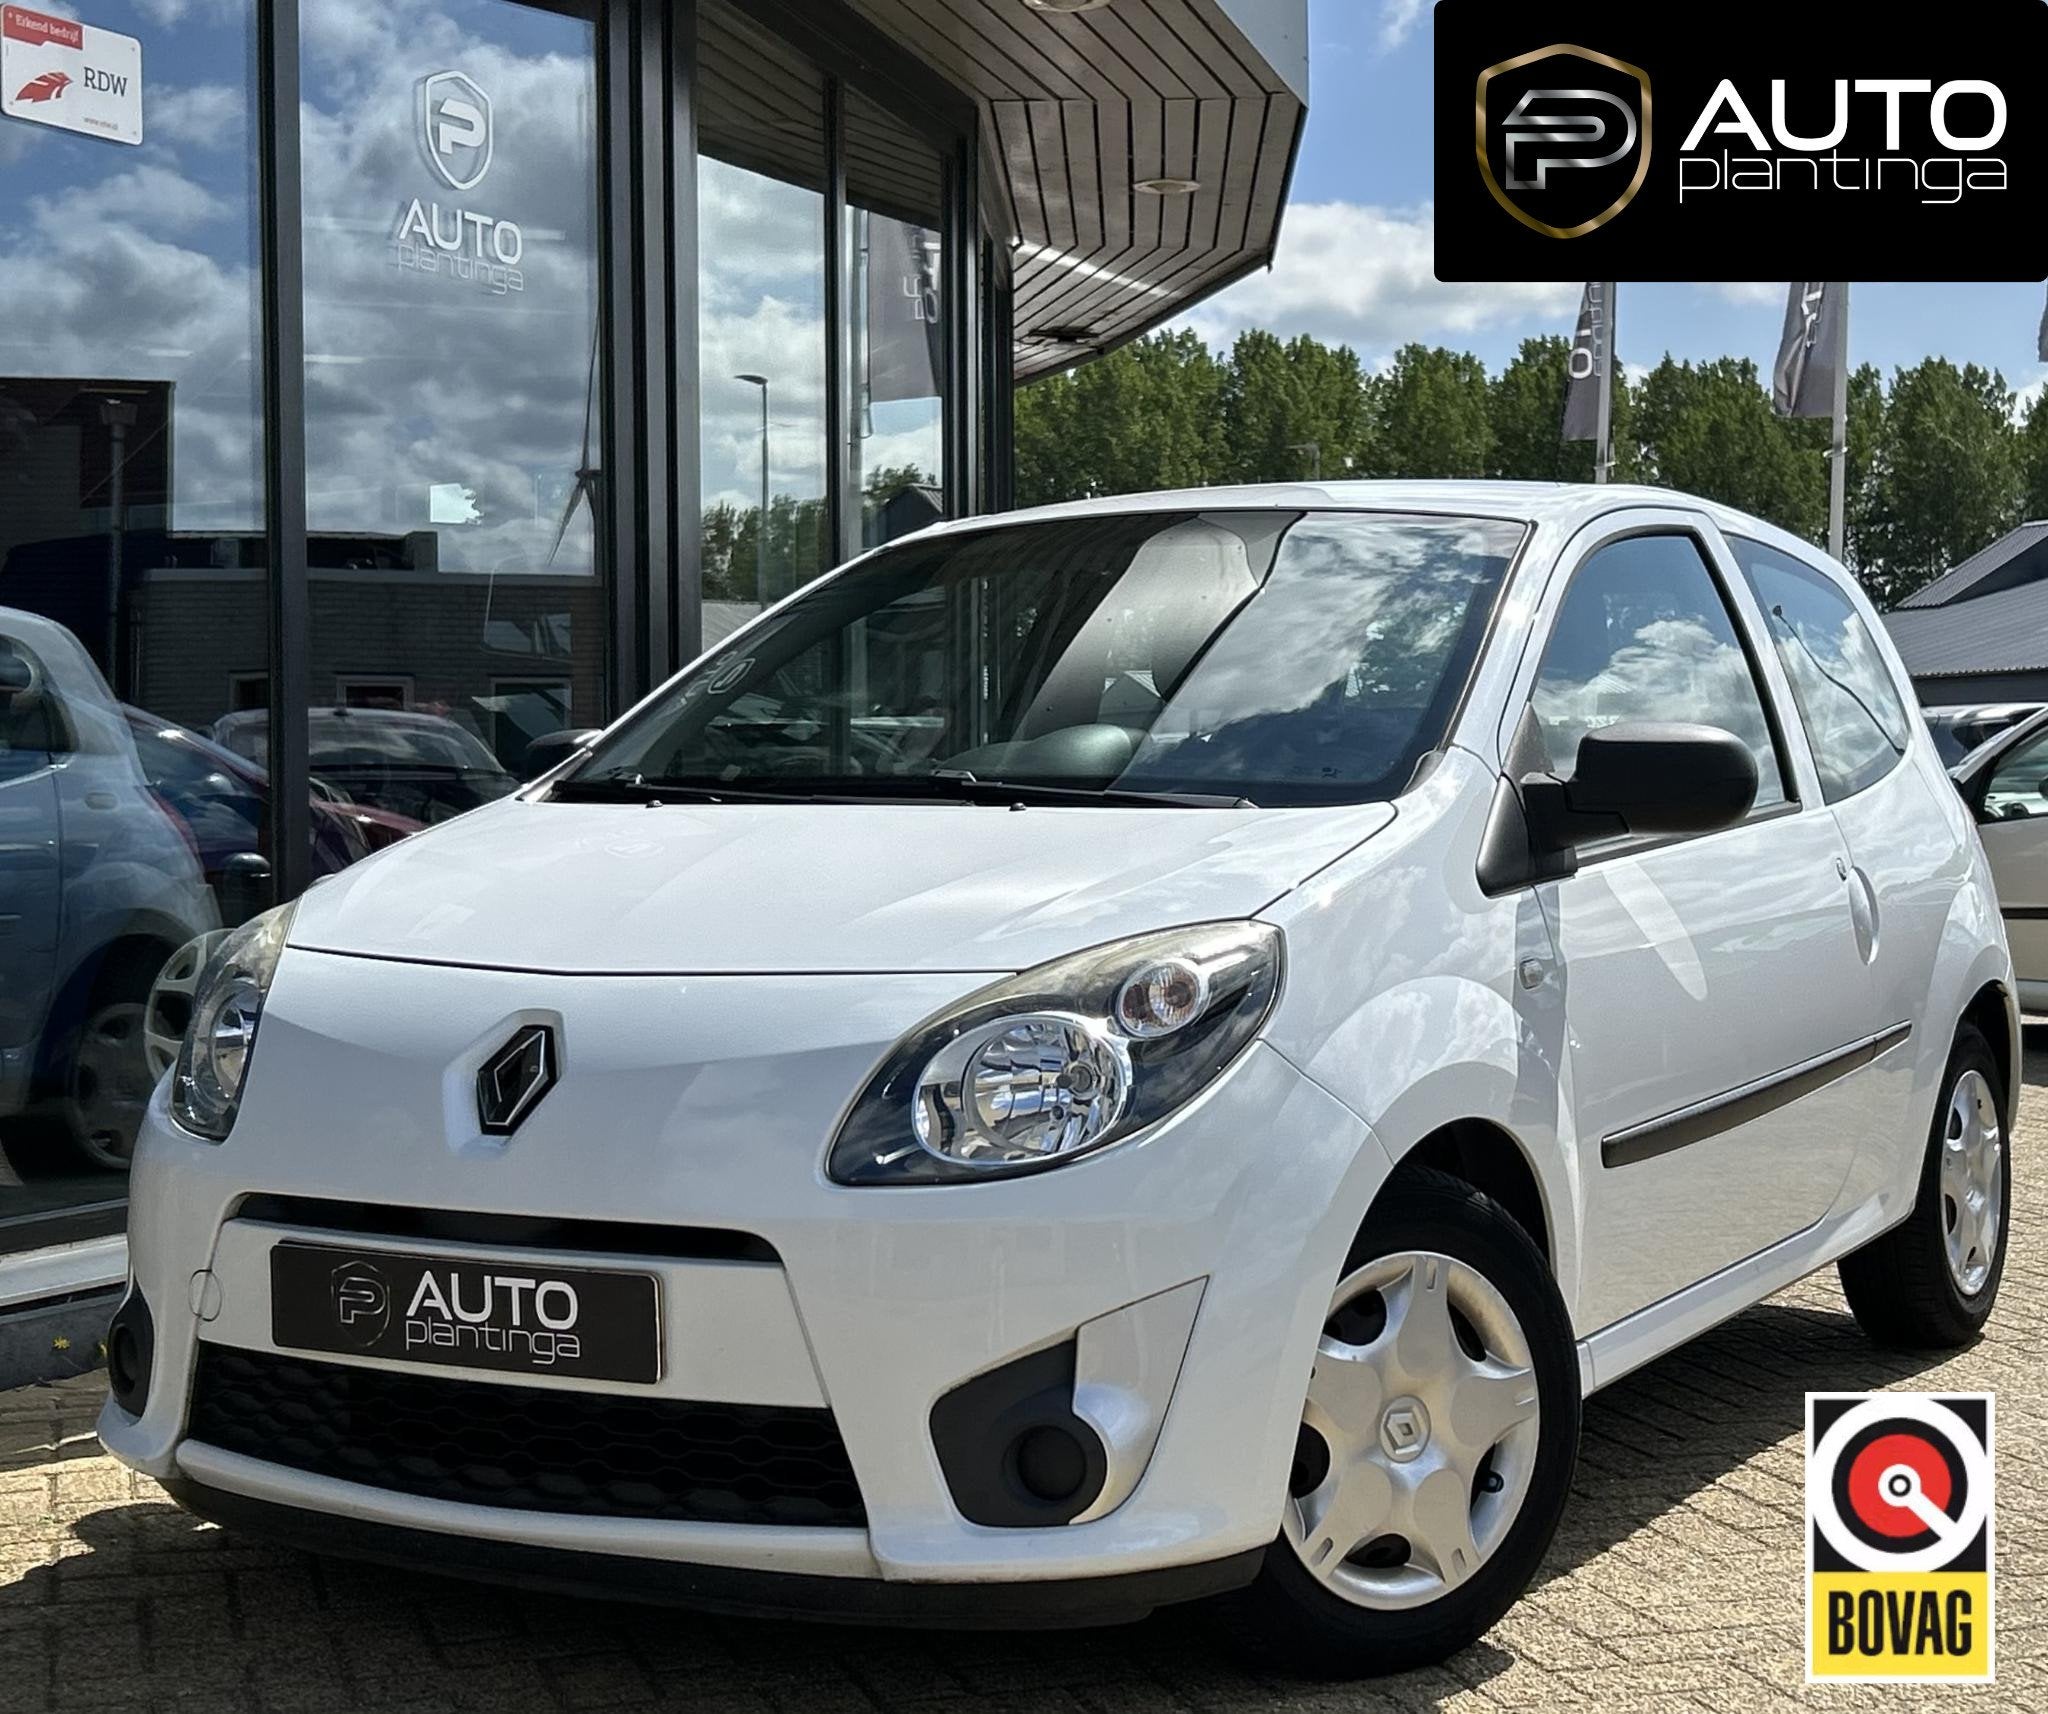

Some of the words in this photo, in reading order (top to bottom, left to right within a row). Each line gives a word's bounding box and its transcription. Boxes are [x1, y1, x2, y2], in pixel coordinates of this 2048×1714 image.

[83, 65, 128, 97] RDW
[399, 197, 522, 265] AUTO
[398, 241, 524, 296] plantinga
[405, 1269, 579, 1331] AUTO
[405, 1316, 581, 1365] plantinga
